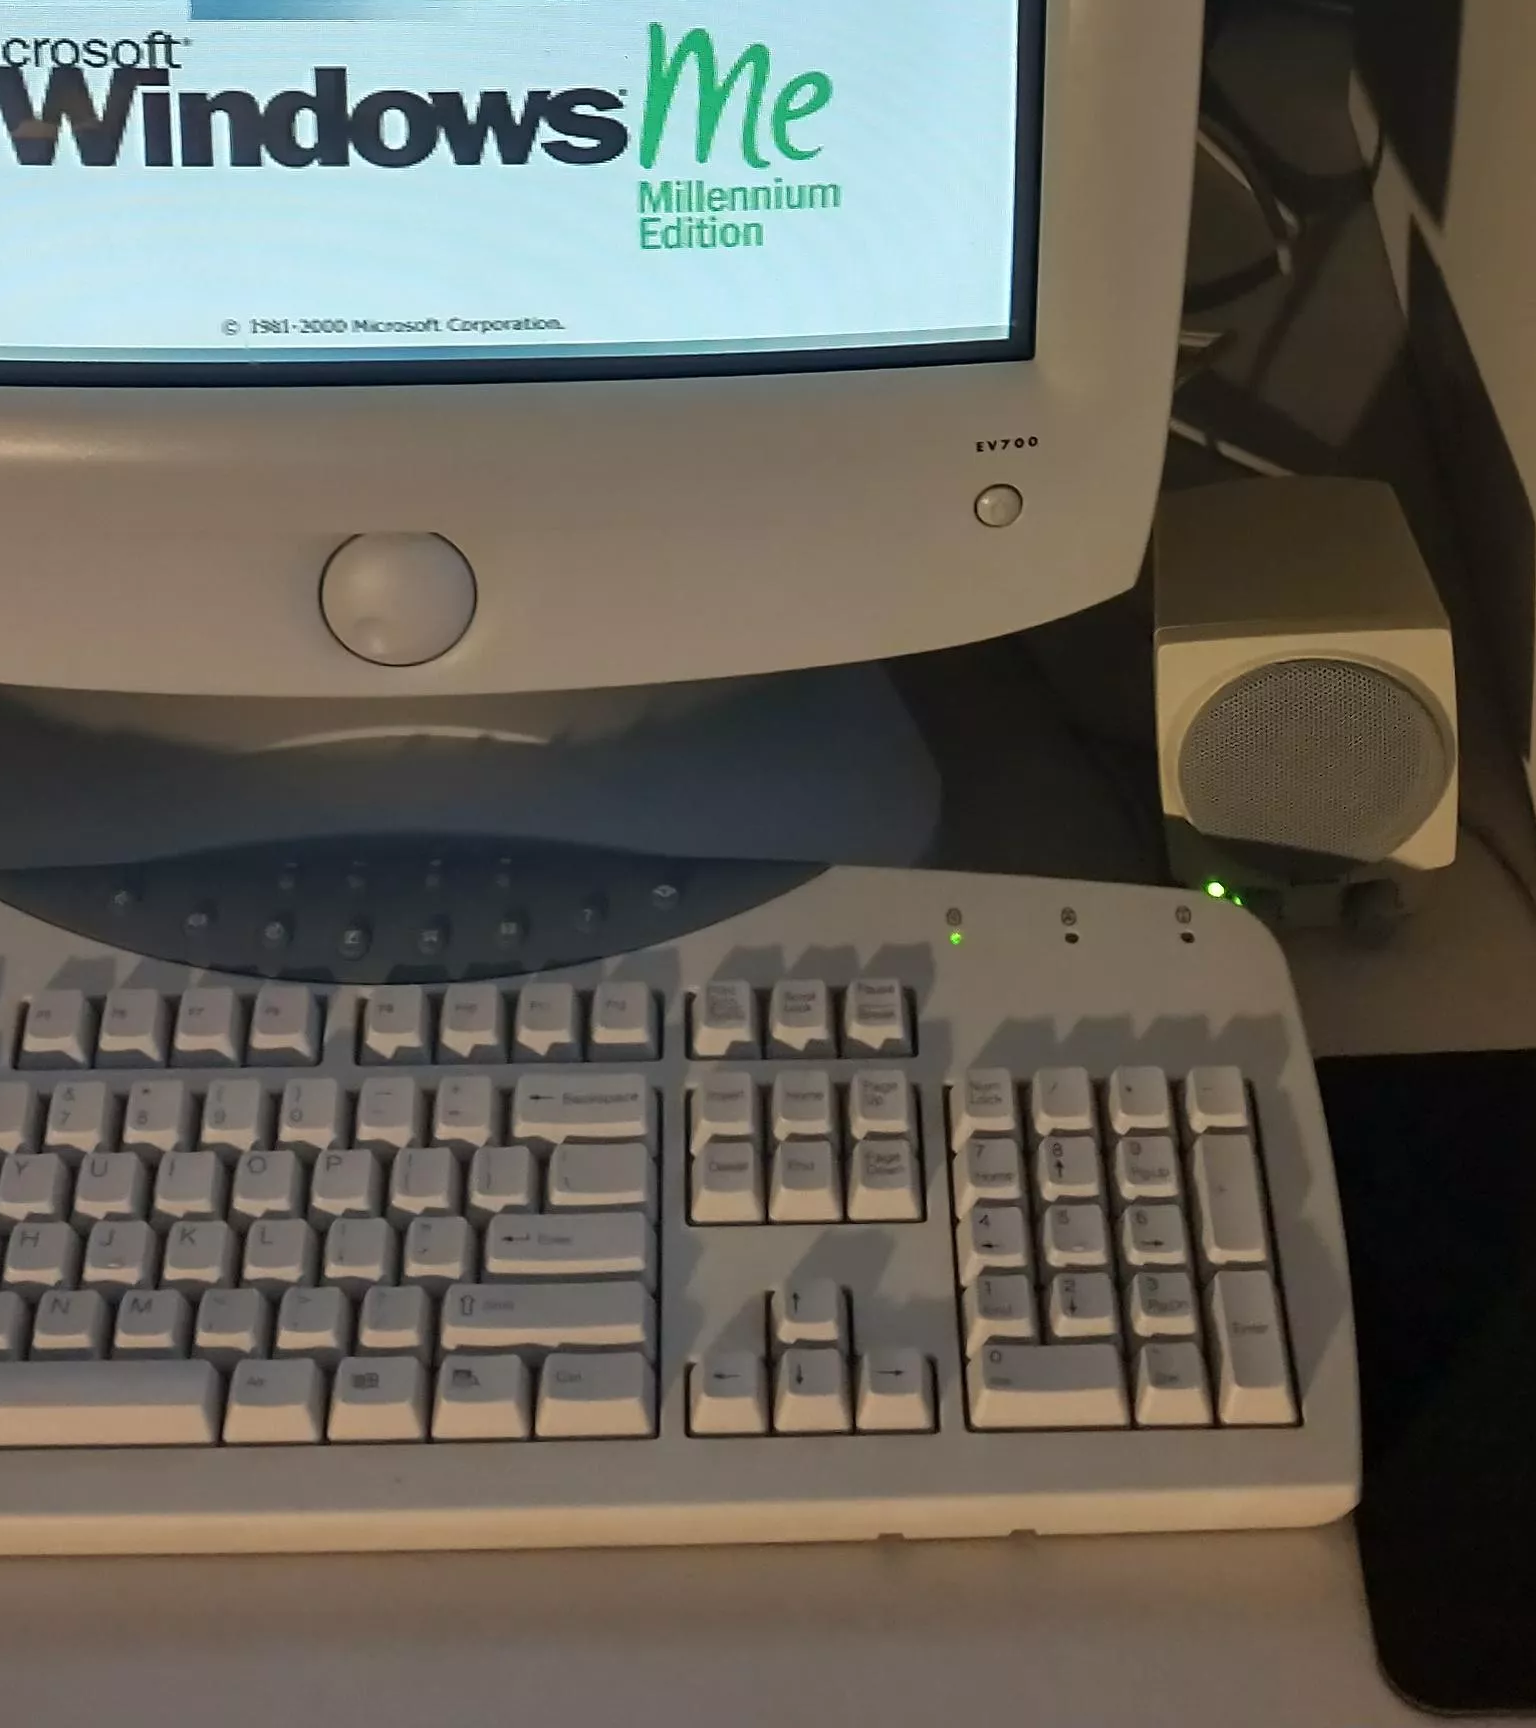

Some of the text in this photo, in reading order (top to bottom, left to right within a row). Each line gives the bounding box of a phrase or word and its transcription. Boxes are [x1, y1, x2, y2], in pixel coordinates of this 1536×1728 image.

[639, 22, 833, 169] Me
[638, 177, 842, 214] Millennium
[639, 216, 764, 250] Edition
[248, 318, 348, 335] 1981-2000
[351, 317, 442, 334] Microsoft
[446, 316, 566, 334] Corporation.
[975, 436, 1039, 453] EV700
[14, 1159, 30, 1177] Y
[90, 1158, 109, 1178] U
[246, 1154, 268, 1174] O
[325, 1153, 344, 1172] P
[19, 1229, 41, 1249] H
[98, 1229, 117, 1248] J
[178, 1226, 198, 1246] K
[259, 1226, 275, 1246] L
[50, 1296, 74, 1316] N
[128, 1296, 154, 1315] M
